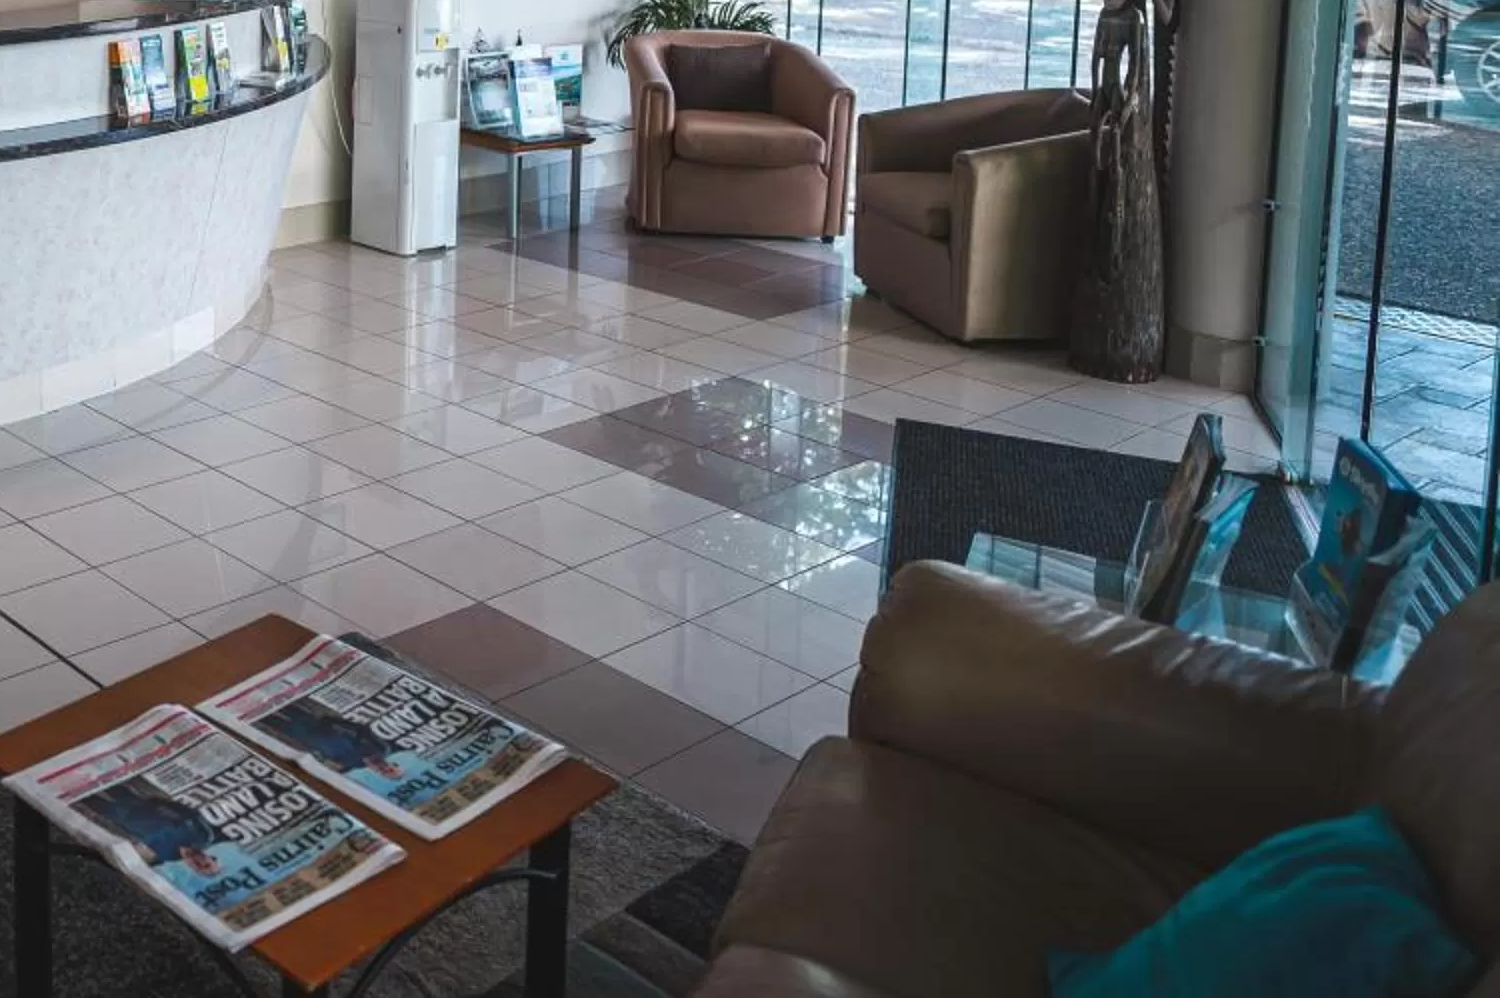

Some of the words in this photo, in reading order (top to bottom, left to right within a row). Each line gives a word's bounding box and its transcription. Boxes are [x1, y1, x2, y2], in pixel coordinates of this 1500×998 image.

[341, 676, 424, 725] BATTLE
[367, 698, 430, 739] LAND
[395, 700, 478, 754] LOSING
[436, 722, 515, 774] Cairns
[172, 756, 267, 809] BATTLE
[198, 779, 272, 826] LAND
[386, 769, 447, 805] Post
[222, 783, 317, 846] LOSING
[256, 810, 353, 874] Cairns
[193, 866, 267, 909] Post
